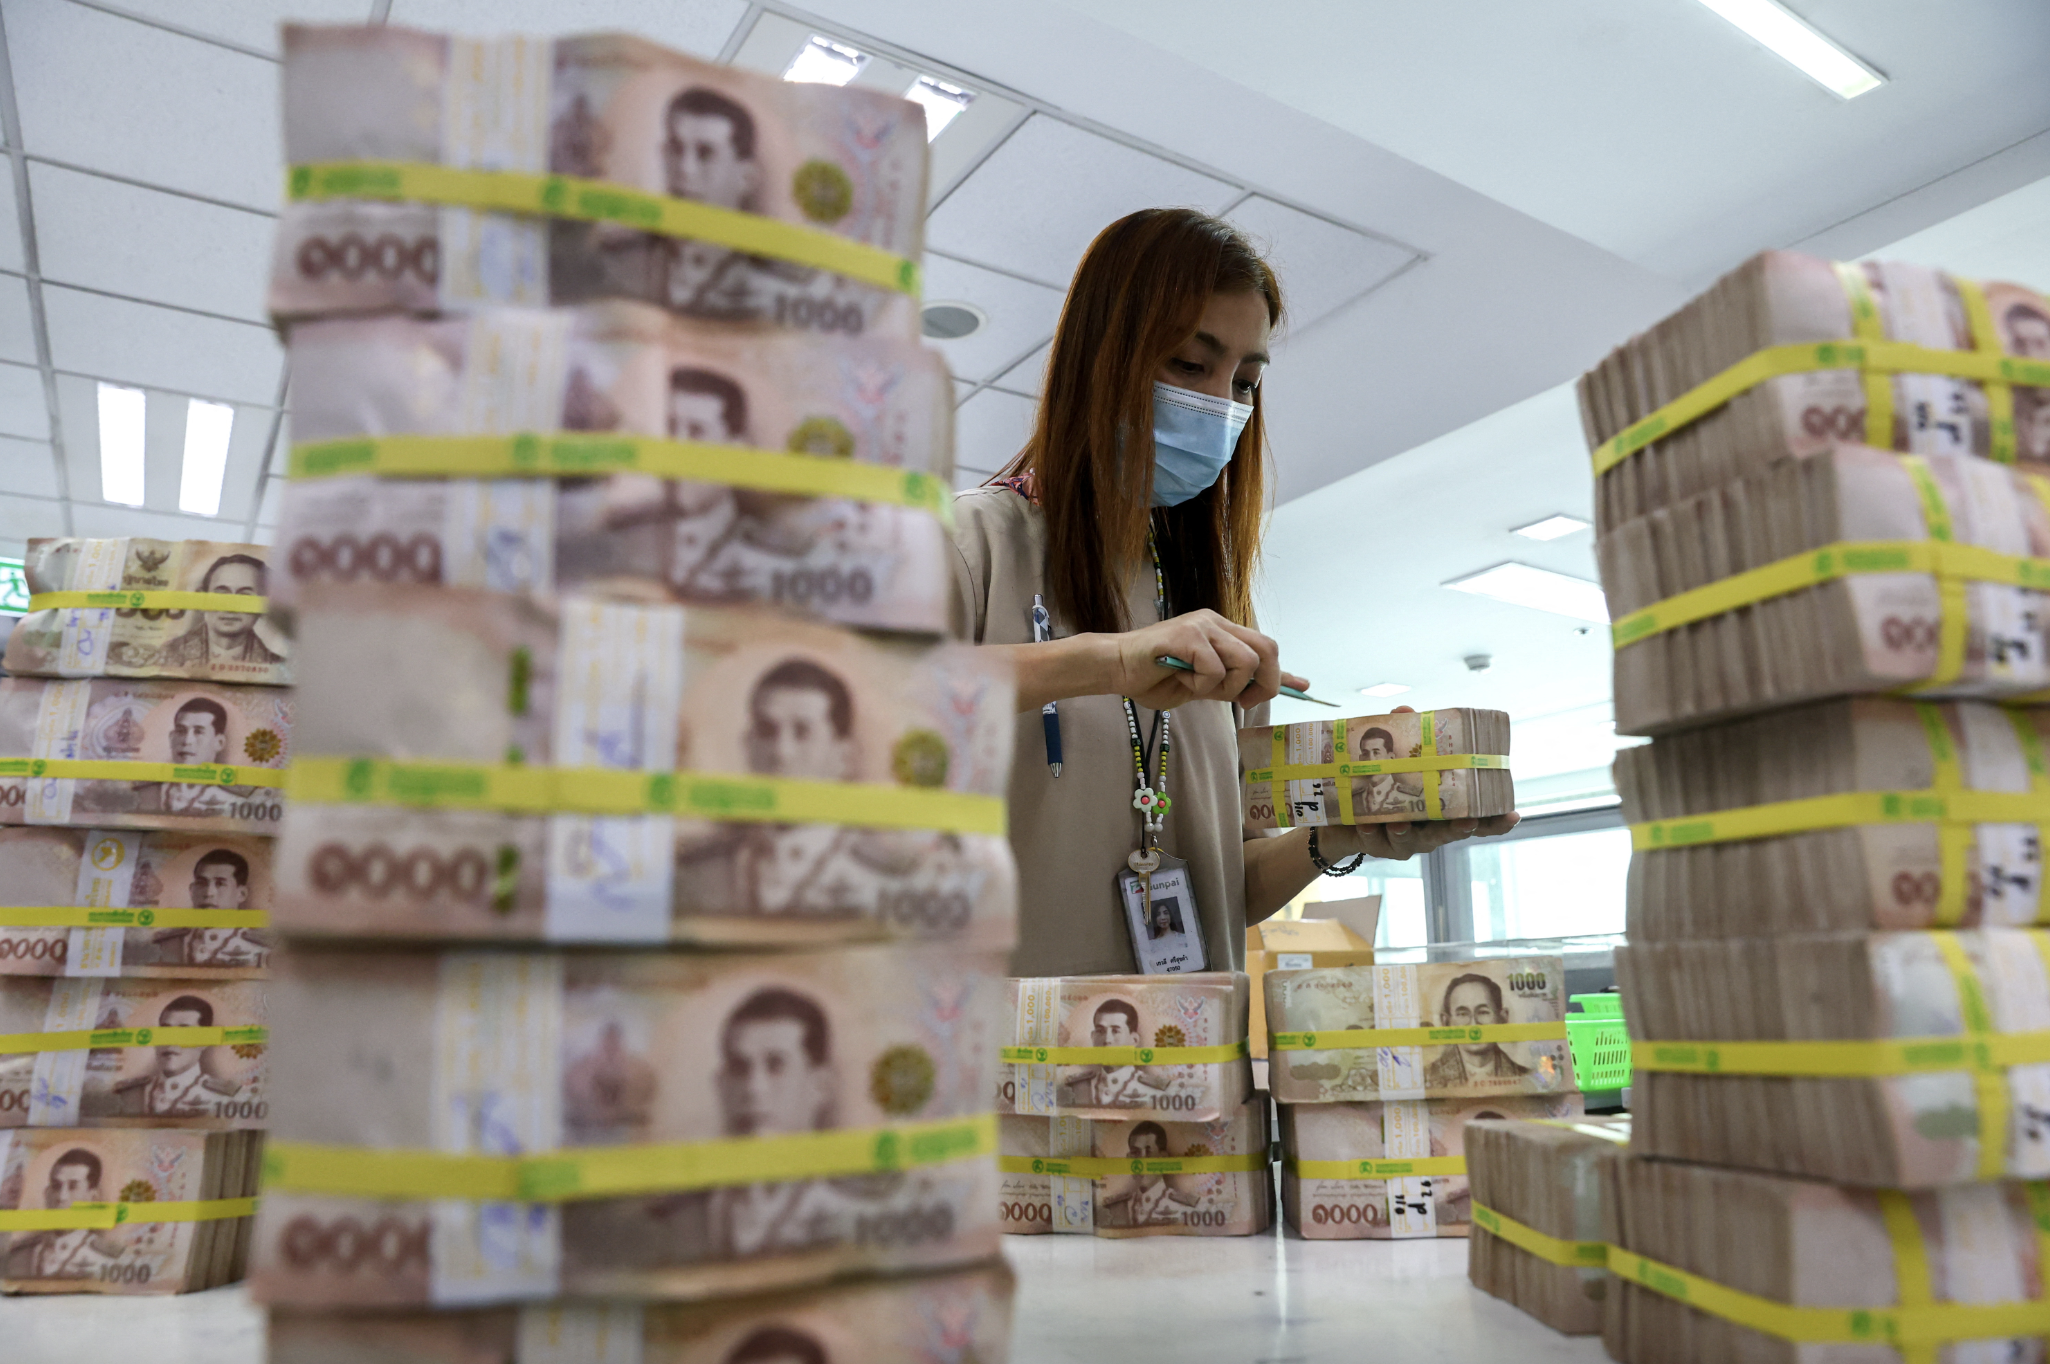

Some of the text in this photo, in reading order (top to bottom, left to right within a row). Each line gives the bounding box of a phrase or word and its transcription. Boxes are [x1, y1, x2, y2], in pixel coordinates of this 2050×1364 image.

[770, 565, 873, 606] 1000
[229, 801, 282, 823] 1000
[1382, 968, 1391, 999] 1,000
[1506, 972, 1546, 991] 1000
[1026, 994, 1036, 1024] 1,000
[214, 1100, 268, 1120] 1000
[1150, 1094, 1196, 1111] 1000
[1394, 1107, 1402, 1138] 1,000
[1181, 1210, 1226, 1227] 1000
[100, 1263, 151, 1284] 1000
